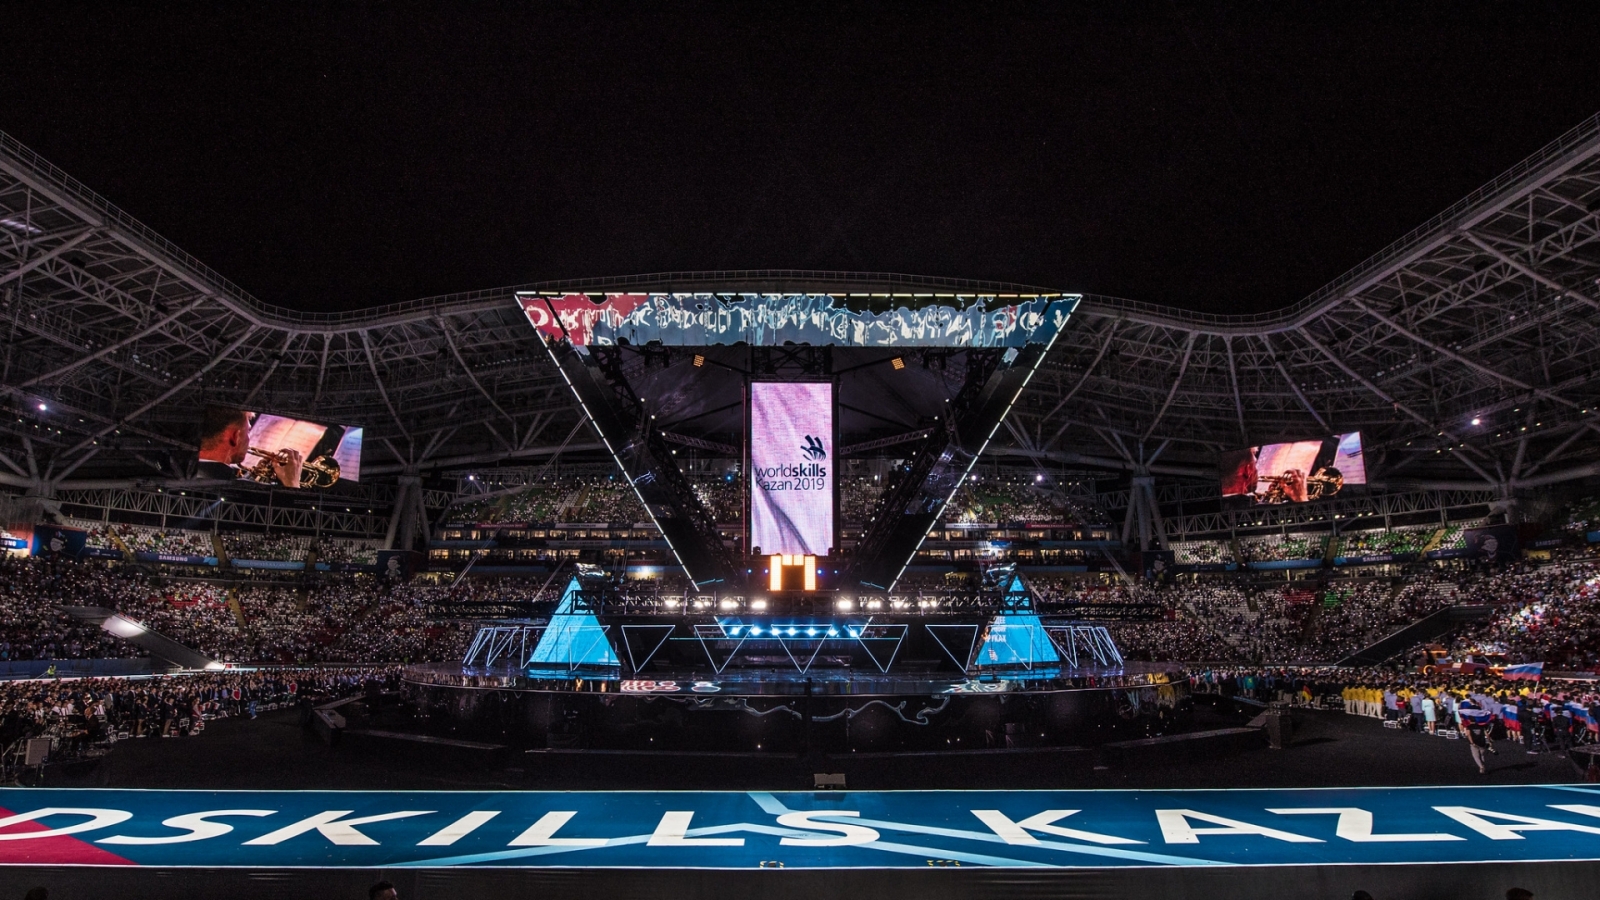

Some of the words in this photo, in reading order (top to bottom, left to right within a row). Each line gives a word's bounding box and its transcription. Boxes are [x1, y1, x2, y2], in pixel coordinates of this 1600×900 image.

[754, 463, 827, 478] worldskills
[755, 477, 793, 491] Kazan
[794, 477, 825, 491] 2019
[1362, 555, 1393, 563] SAMSUNG
